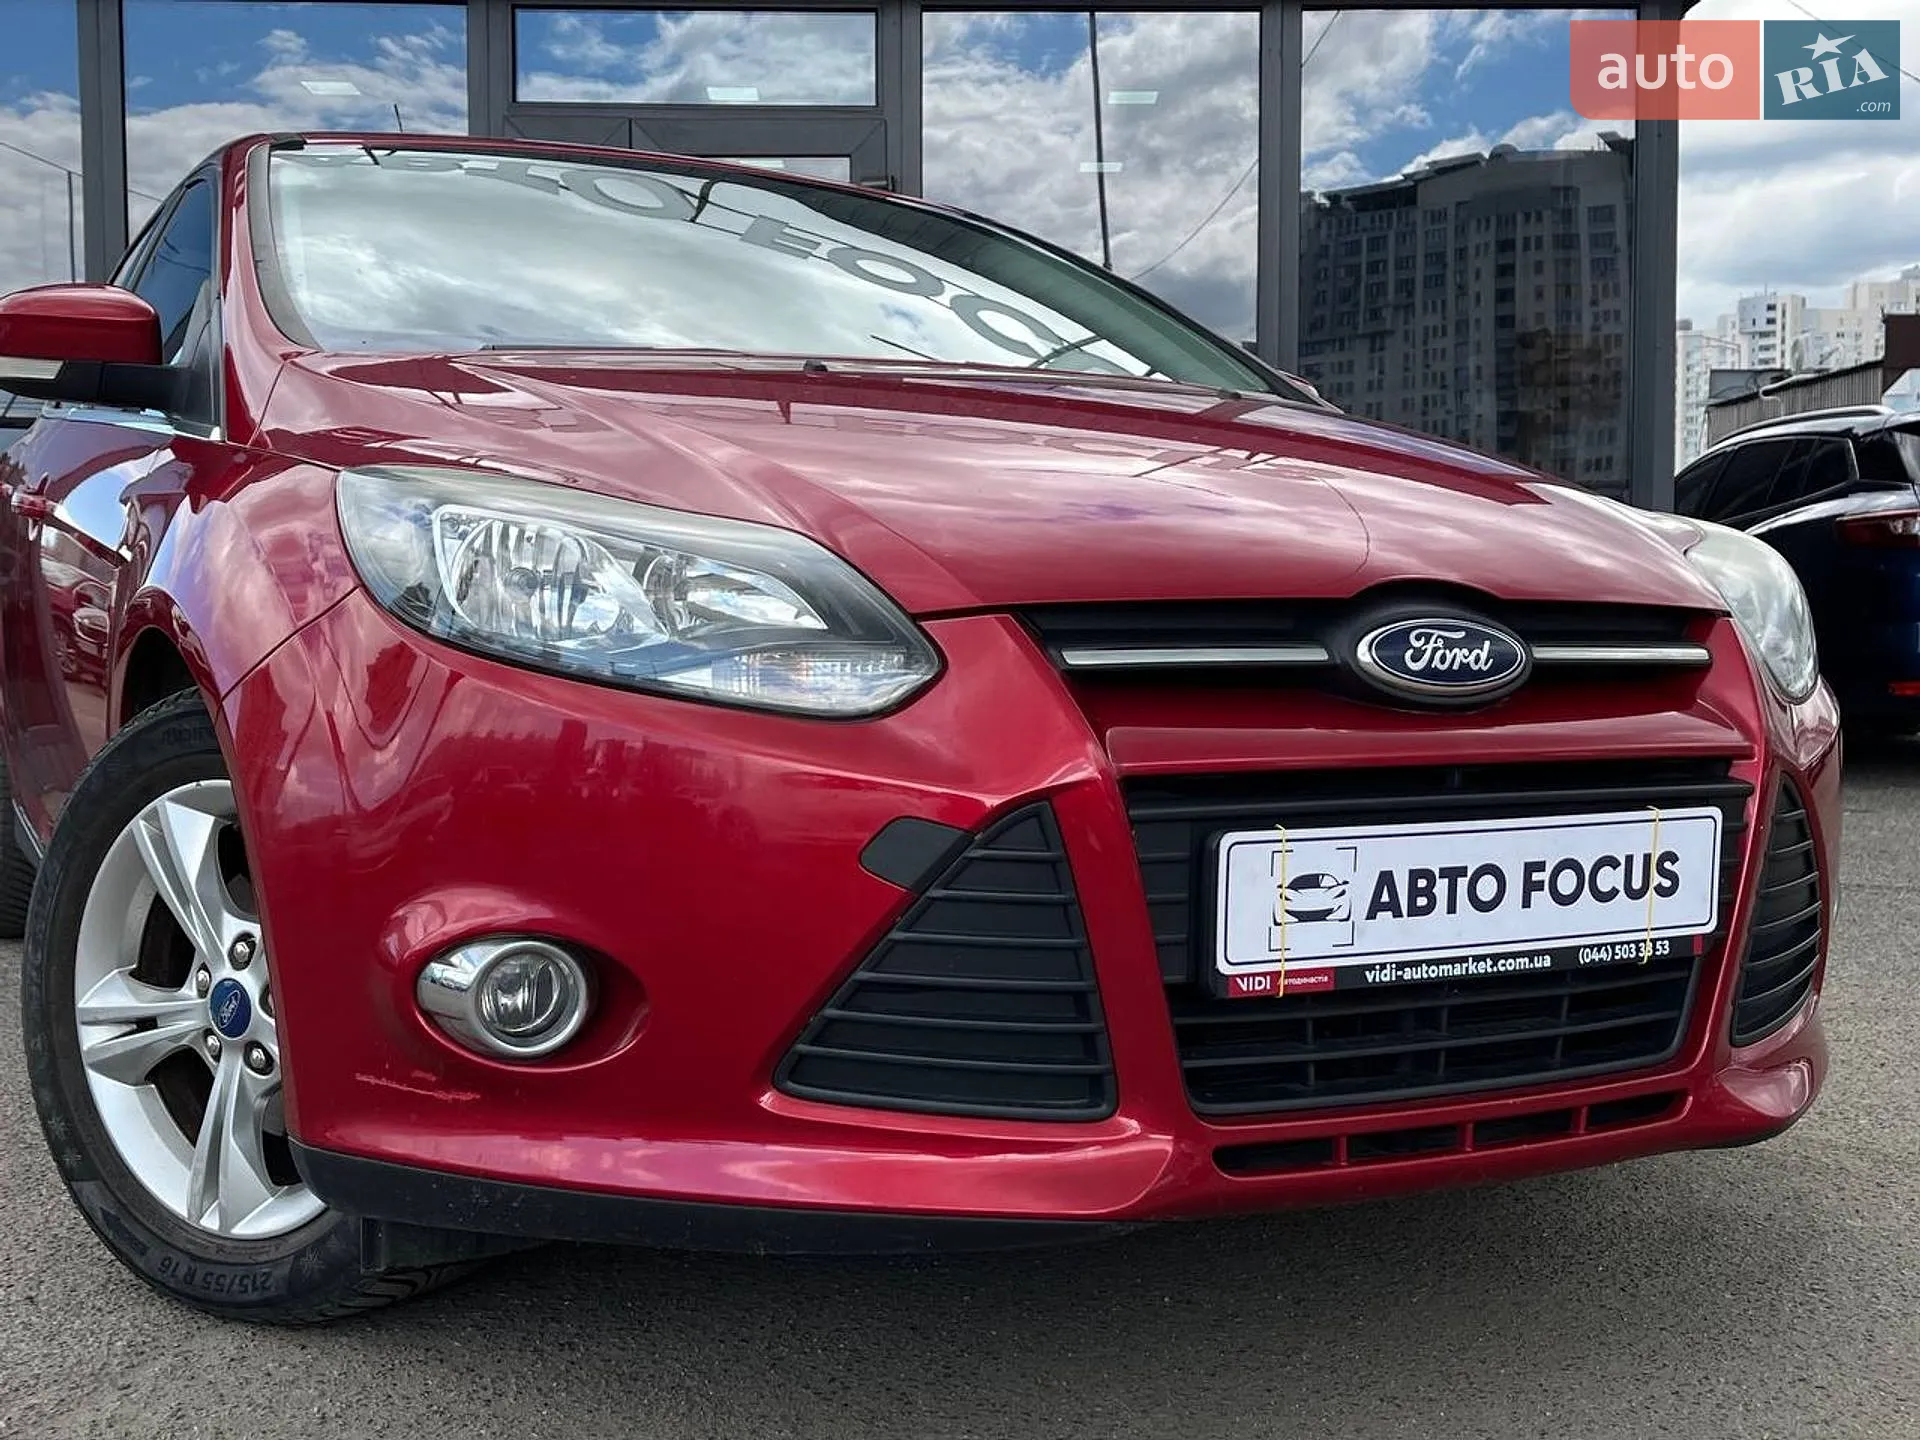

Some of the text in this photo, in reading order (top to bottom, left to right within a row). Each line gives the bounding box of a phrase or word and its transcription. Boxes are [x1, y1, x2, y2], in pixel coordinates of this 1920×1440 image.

[1404, 628, 1493, 671] Ford
[1365, 850, 1680, 921] АВТО FOCUS
[1365, 954, 1551, 984] vidi-automarket.com.ua
[1578, 945, 1612, 964] (044)
[1614, 943, 1636, 959] 503
[1655, 940, 1669, 955] 53
[1236, 975, 1271, 991] VIDI
[157, 1255, 273, 1295] 215/55 R 16
